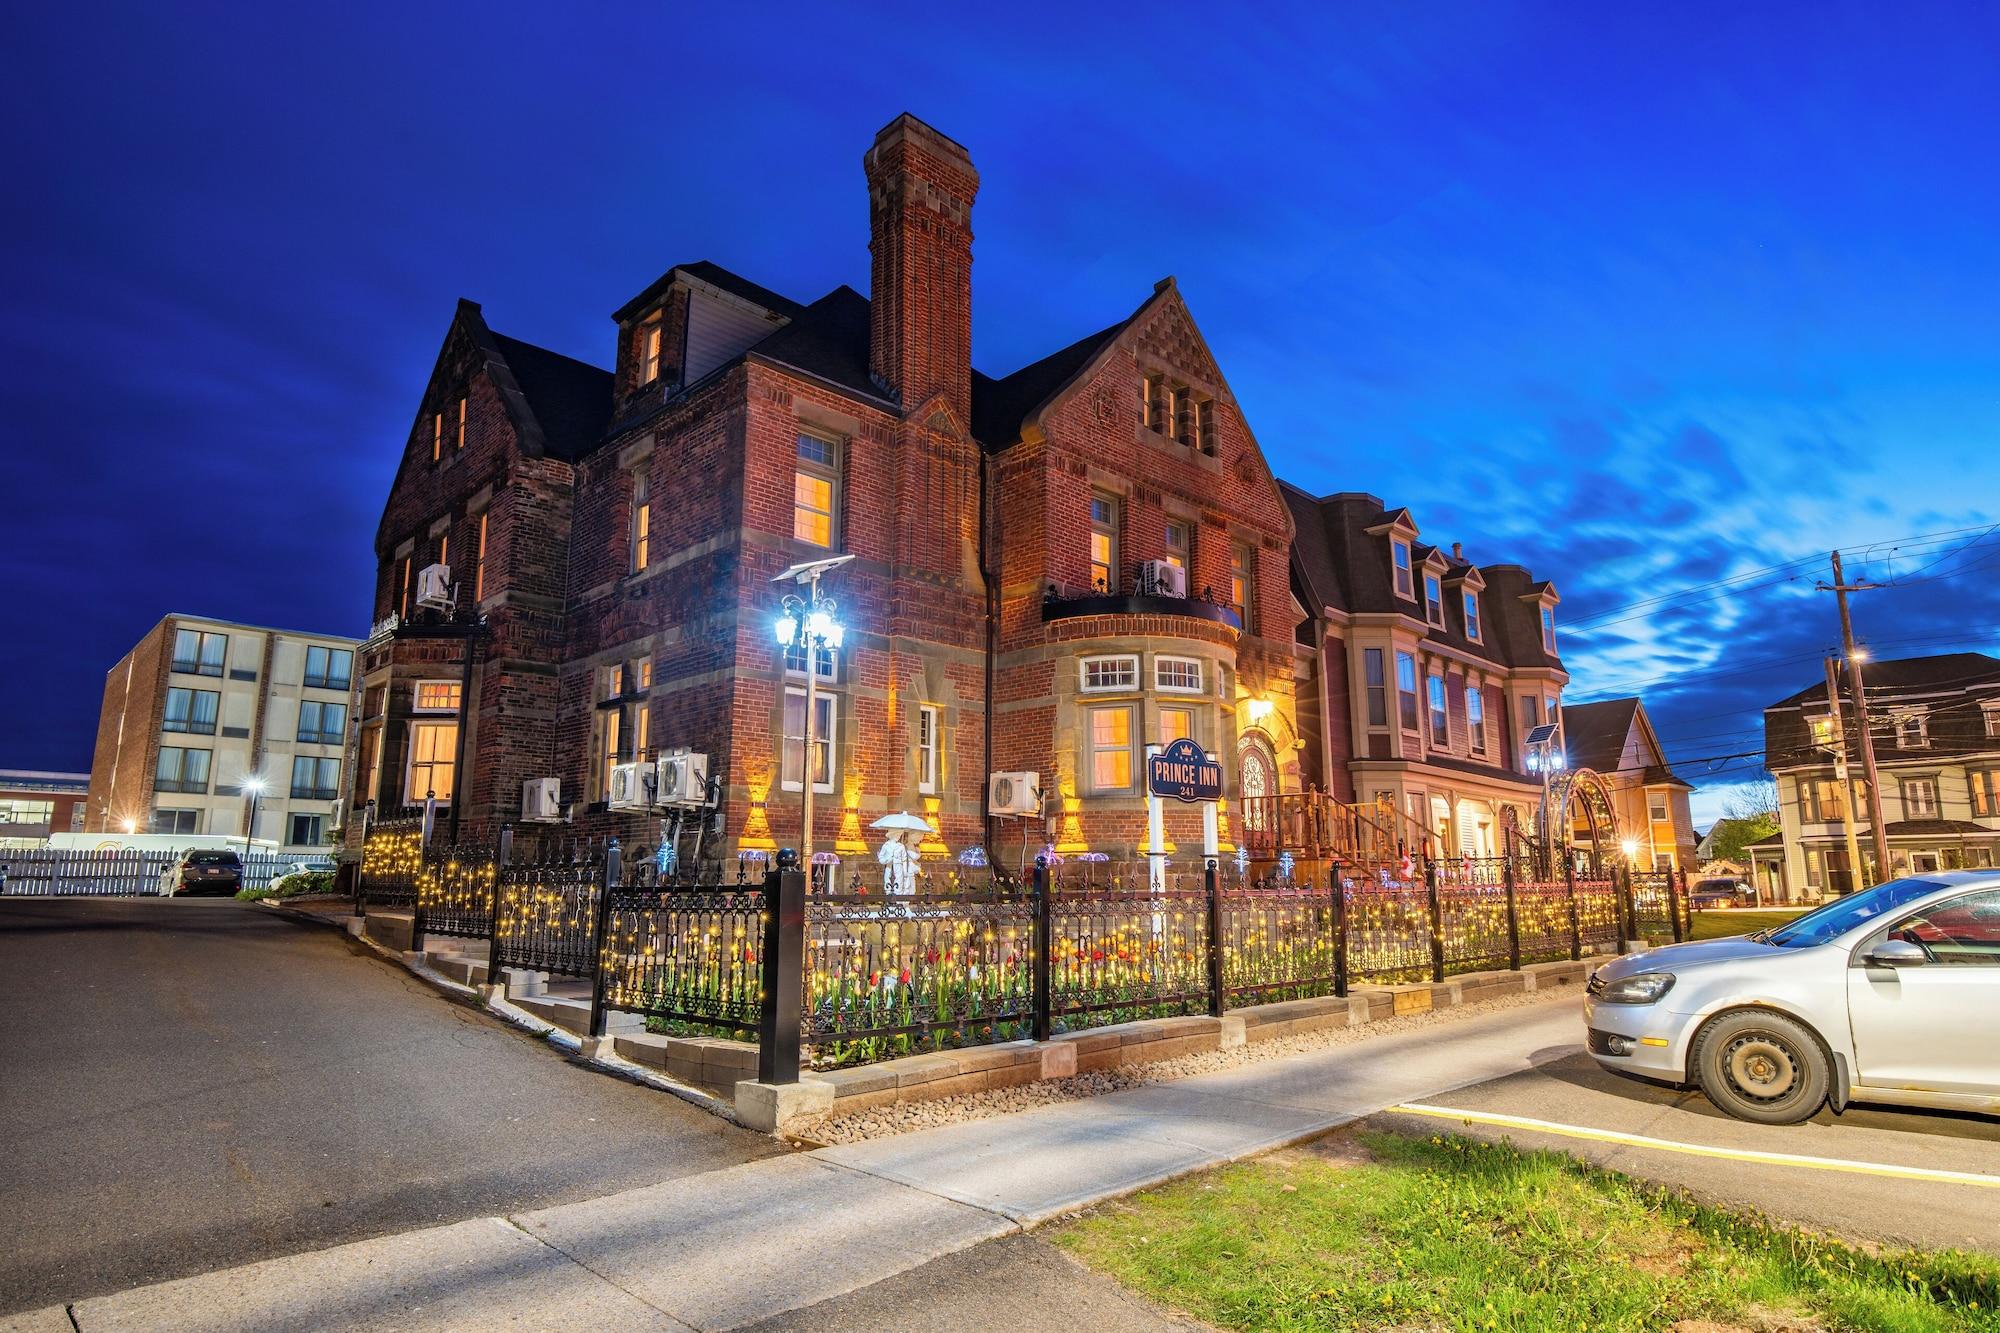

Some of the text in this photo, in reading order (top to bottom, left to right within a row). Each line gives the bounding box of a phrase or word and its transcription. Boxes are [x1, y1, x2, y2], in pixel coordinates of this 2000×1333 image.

[1155, 761, 1217, 786] PRINCE INN
[1180, 786, 1194, 796] 241
